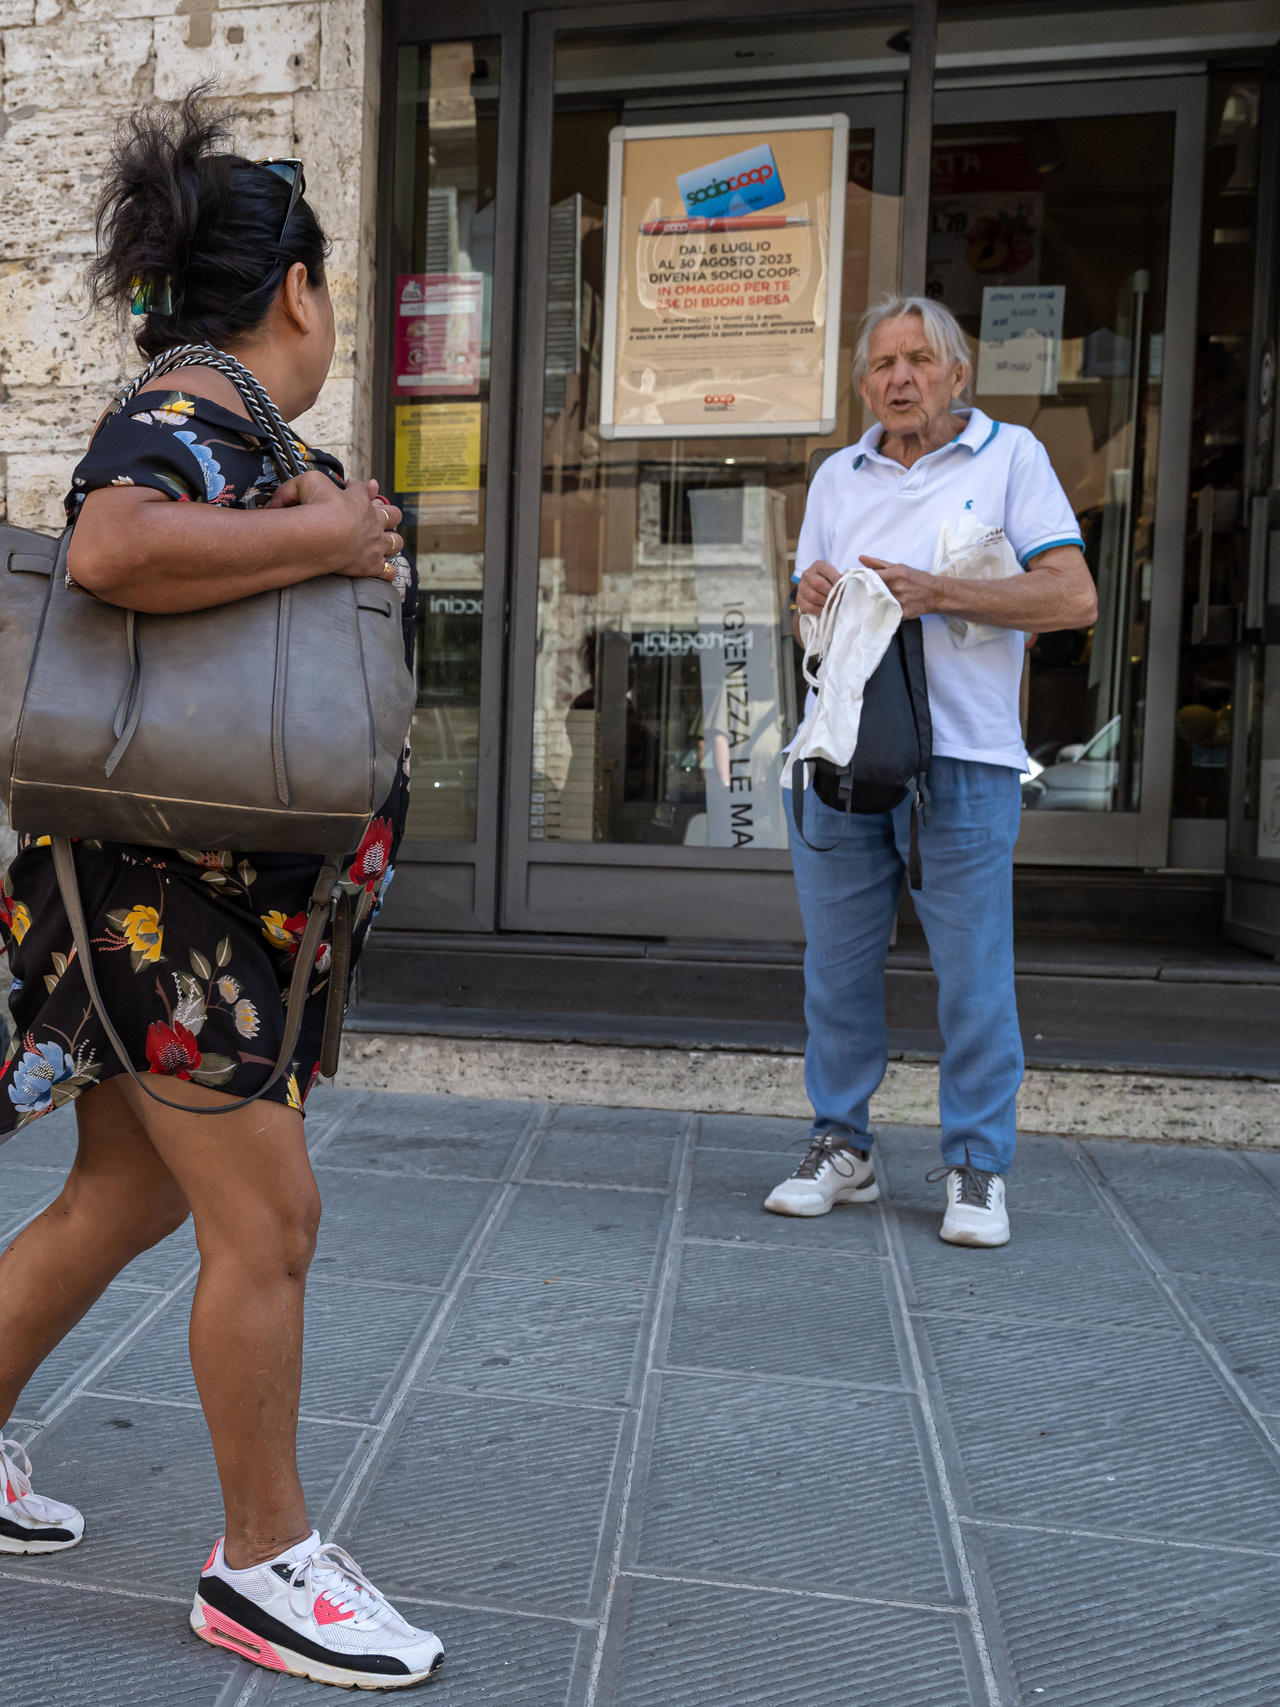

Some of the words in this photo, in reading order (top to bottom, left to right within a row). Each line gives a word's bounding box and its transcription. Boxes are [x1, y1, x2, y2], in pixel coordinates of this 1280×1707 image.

[687, 164, 773, 207] sociocoop
[679, 245, 705, 256] DAL
[709, 244, 718, 255] 6
[721, 241, 771, 254] LUGLIO
[658, 259, 675, 270] AL
[679, 258, 695, 269] 30
[699, 255, 756, 268] AGOSTO
[759, 253, 792, 265] 2023
[649, 272, 707, 284] DIVENTA
[711, 269, 754, 281] SOCIO
[757, 267, 801, 278] COOP:
[657, 286, 671, 297] IN
[675, 283, 741, 296] OMAGGIO
[744, 281, 770, 293] PER
[773, 280, 790, 291] TE
[656, 298, 681, 311] 25€
[684, 298, 698, 309] DI
[701, 295, 744, 308] BUONI
[747, 293, 791, 306] SPESA
[704, 393, 735, 407] coop
[722, 601, 751, 749] IGIENIZZA
[728, 758, 753, 794] LE
